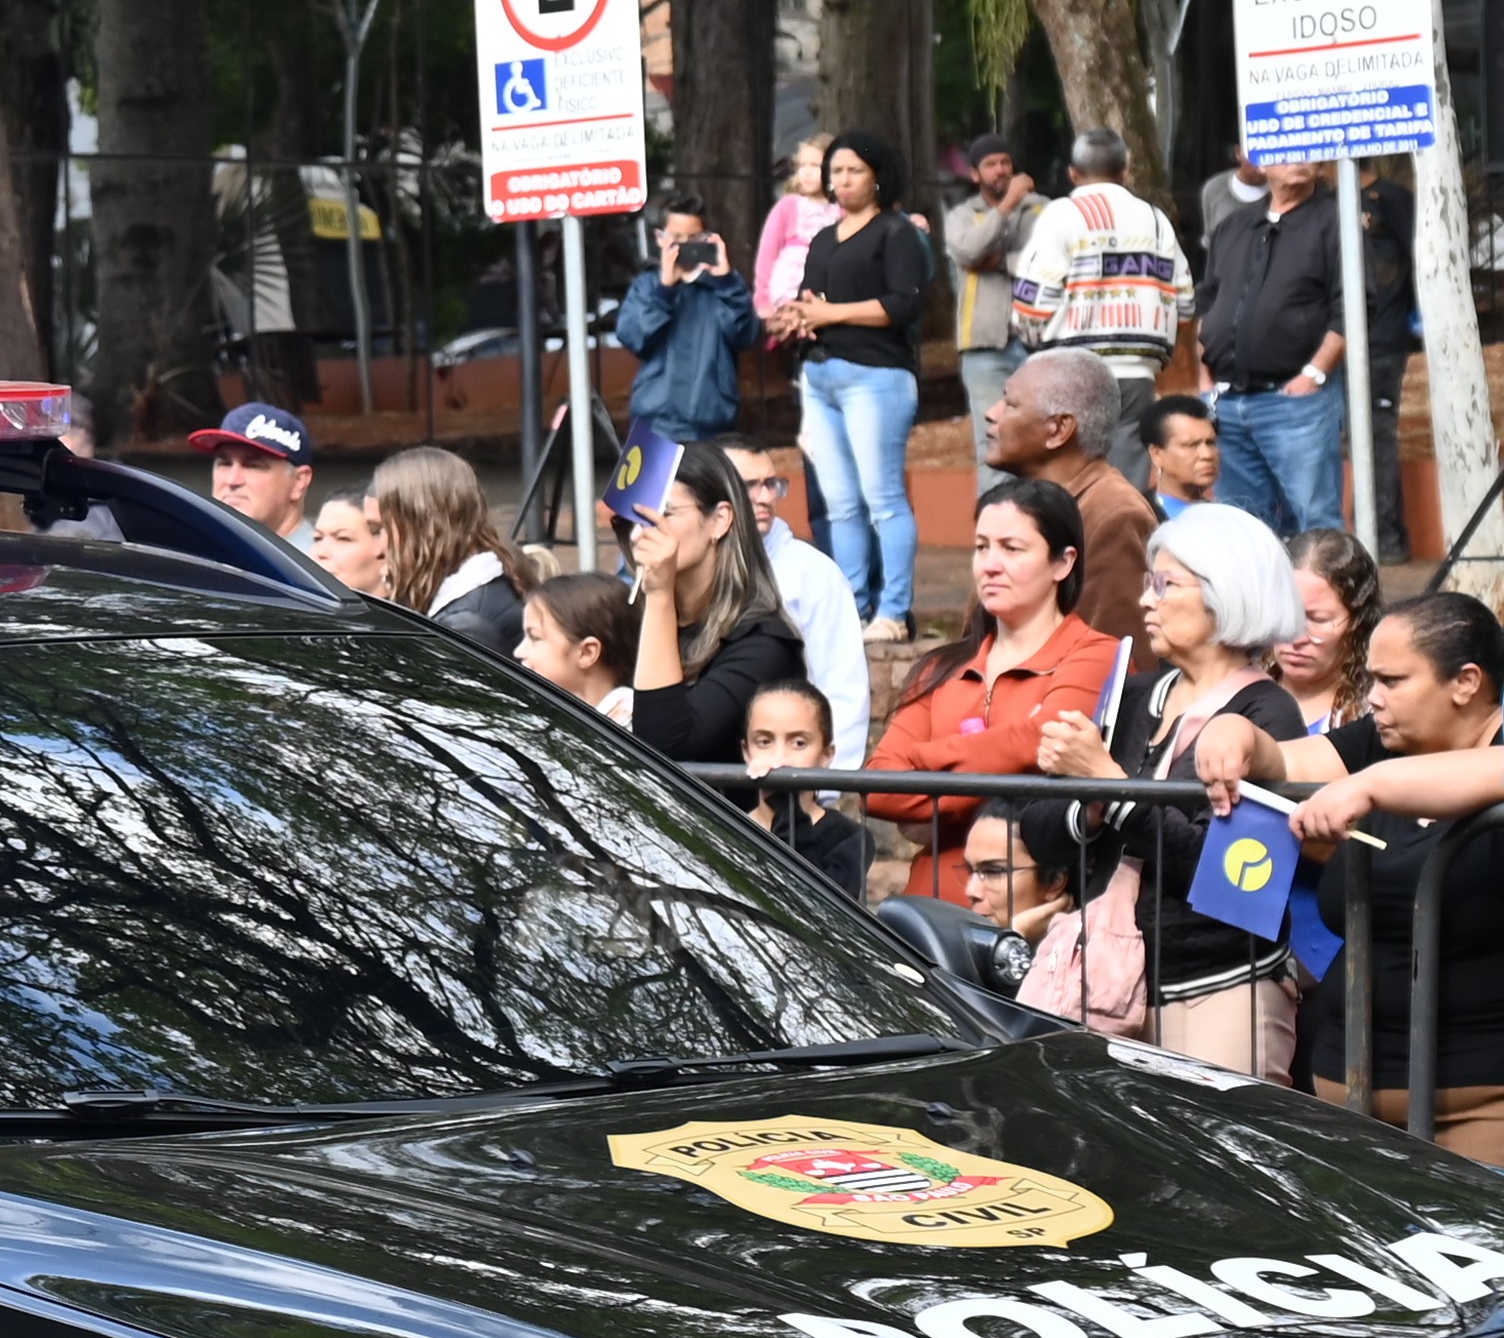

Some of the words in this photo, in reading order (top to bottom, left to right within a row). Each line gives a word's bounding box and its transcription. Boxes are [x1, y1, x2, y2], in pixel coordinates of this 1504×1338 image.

[1292, 6, 1378, 40] IDOSO
[1249, 69, 1271, 85] NA
[1274, 64, 1319, 84] VAGA
[1325, 51, 1425, 78] DELIMITADA
[1282, 116, 1305, 131] DE
[1308, 105, 1412, 128] CREDENCIAL
[1414, 102, 1428, 116] E
[1248, 128, 1345, 151] PAGAMENTO
[1348, 126, 1372, 140] DE
[1375, 119, 1434, 138] TARIFA
[667, 1129, 853, 1158] POLÍCIA
[902, 1201, 1054, 1228] CIVIL
[1006, 1226, 1047, 1239] SP
